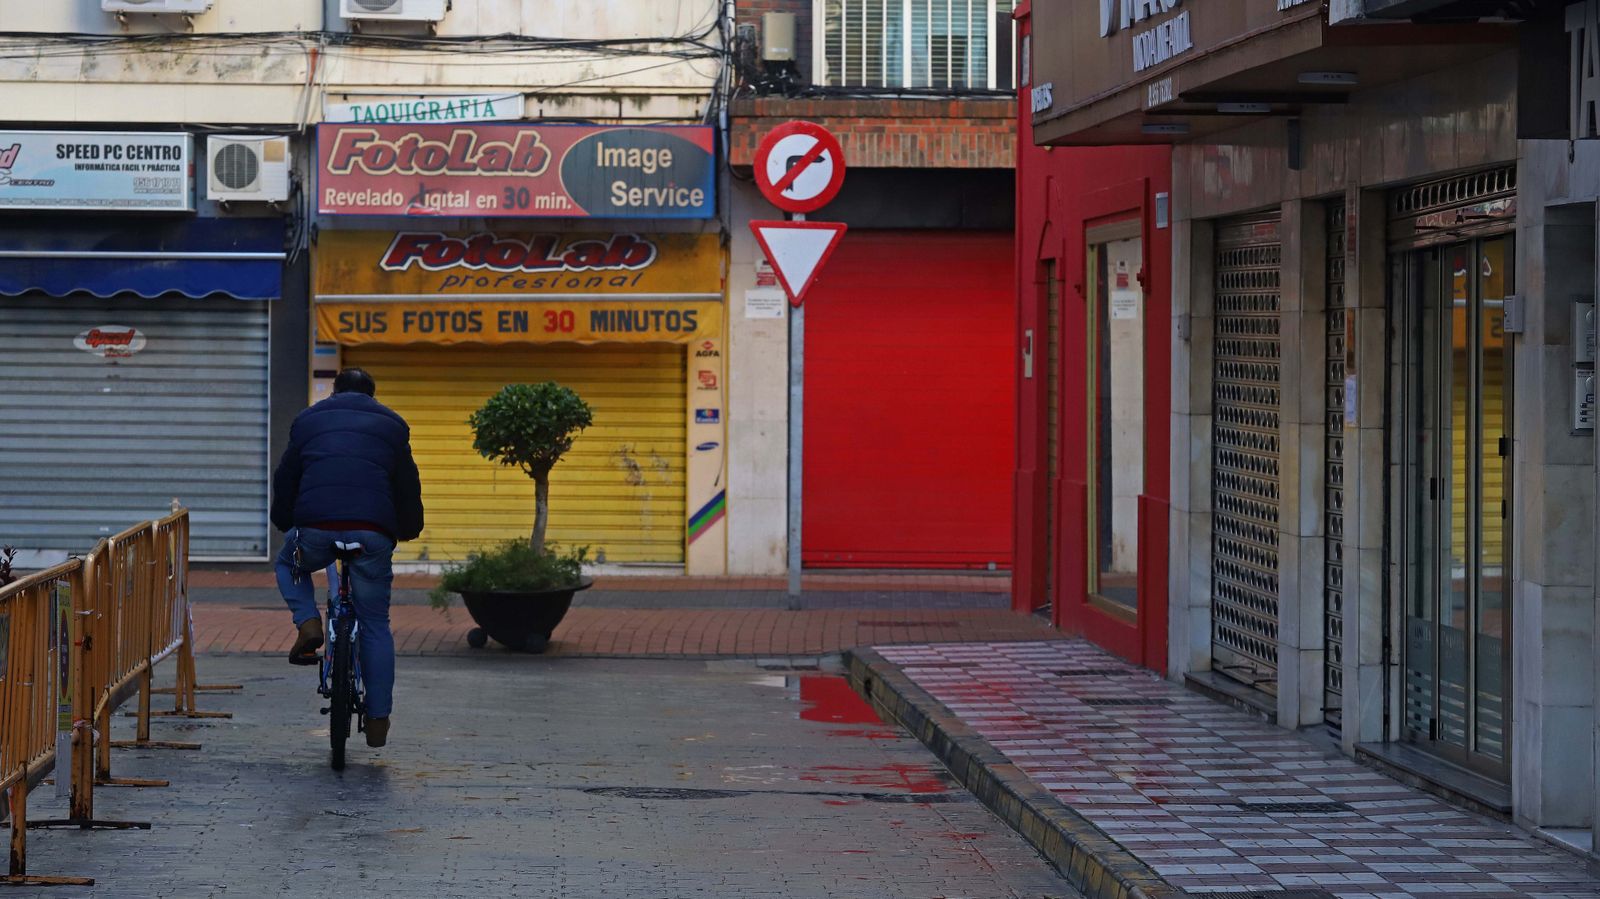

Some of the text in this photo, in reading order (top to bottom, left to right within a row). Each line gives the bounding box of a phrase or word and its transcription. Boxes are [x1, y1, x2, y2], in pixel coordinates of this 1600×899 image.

[350, 98, 496, 123] TAQUIGRAFIA
[56, 143, 181, 160] SPEED PC CENTRO
[327, 128, 552, 177] FotoLab
[597, 142, 672, 174] Image
[74, 162, 120, 171] INFORMÁTICA
[325, 188, 404, 206] Revelado
[476, 194, 497, 209] en
[502, 186, 530, 210] 30
[535, 192, 571, 210] min.
[611, 180, 704, 207] Service
[379, 232, 657, 273] FotoLab
[438, 272, 643, 291] profesional
[339, 309, 698, 333] SUS FOTOS EN 30 MINUTOS
[695, 350, 720, 358] AGFA
